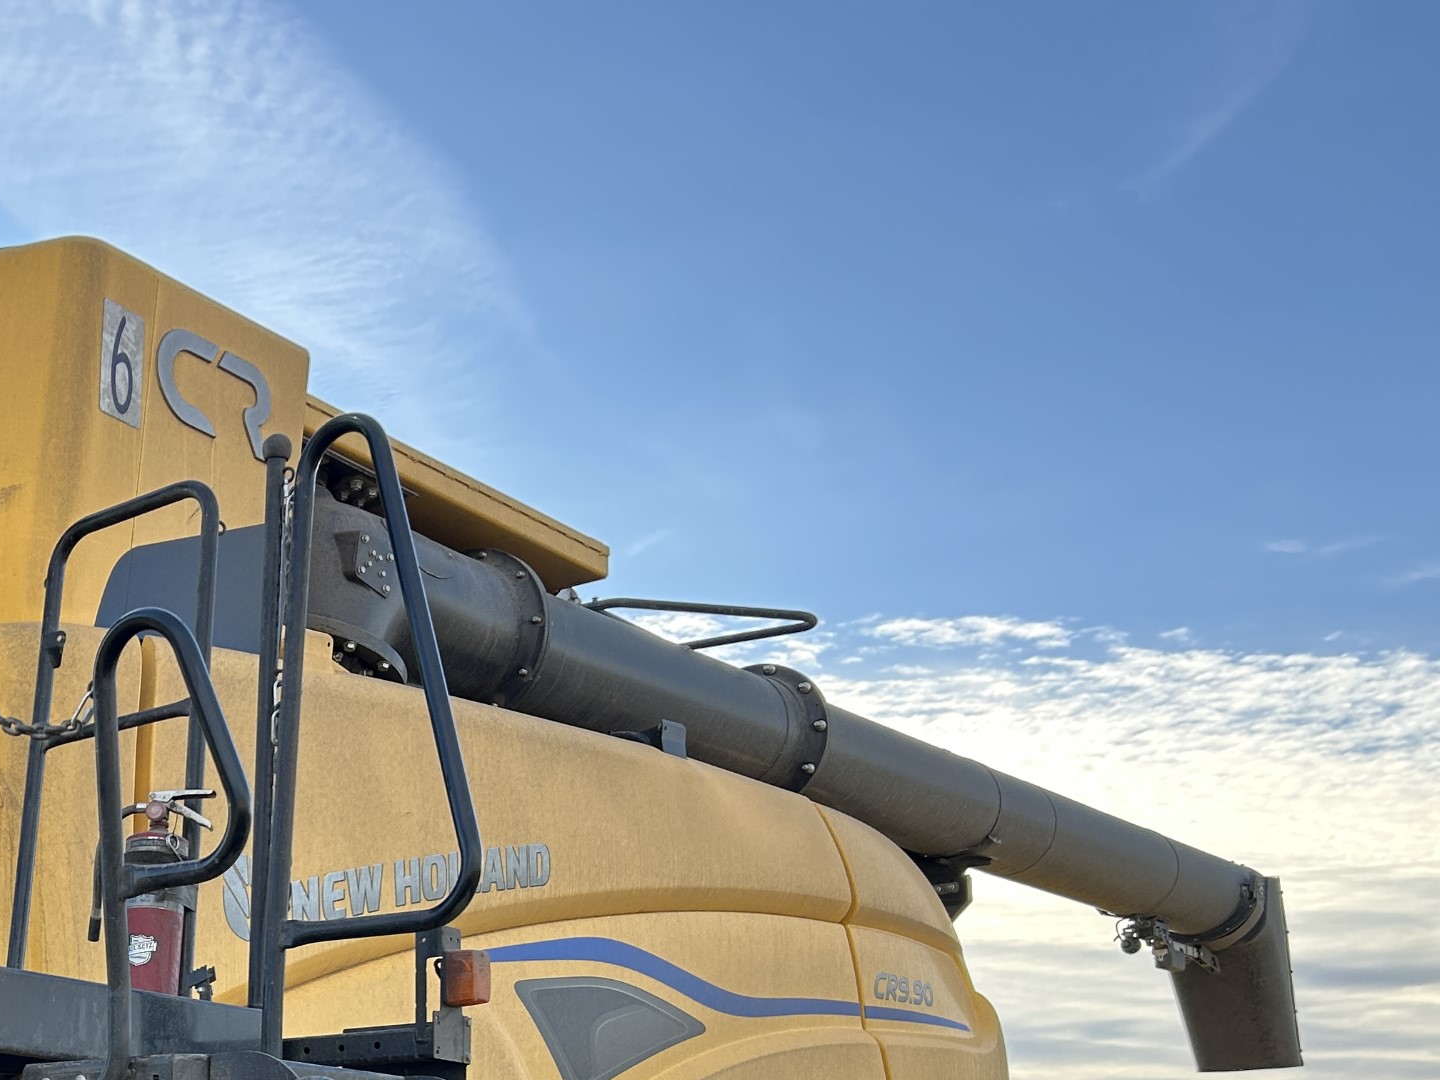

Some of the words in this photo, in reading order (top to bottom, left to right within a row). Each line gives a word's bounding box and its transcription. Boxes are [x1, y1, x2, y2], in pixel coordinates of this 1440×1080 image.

[111, 315, 133, 415] 6
[290, 863, 383, 921] NEW
[874, 972, 934, 1007] CR9.90
